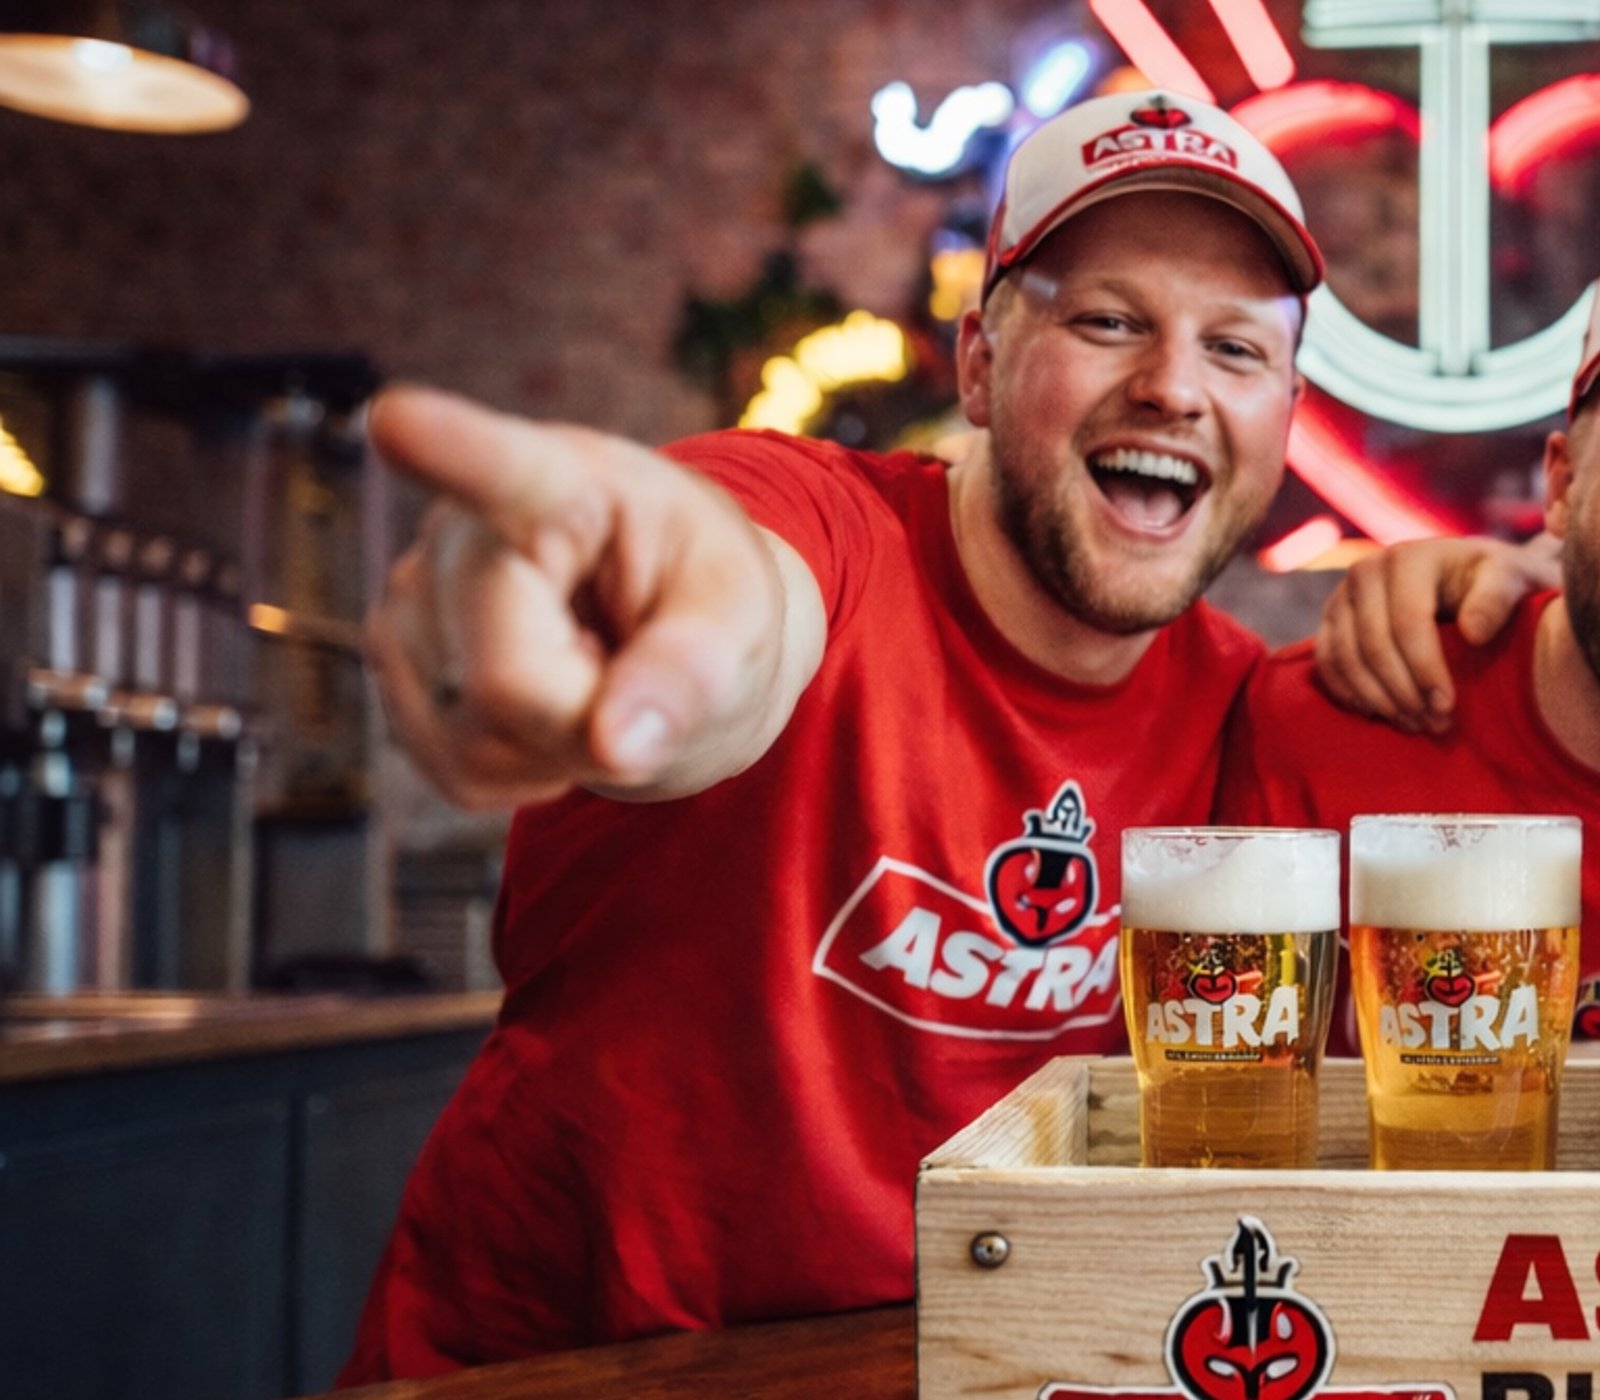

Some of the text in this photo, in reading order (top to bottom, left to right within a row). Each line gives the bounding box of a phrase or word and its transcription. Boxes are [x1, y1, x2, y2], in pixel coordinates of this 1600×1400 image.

[1093, 129, 1231, 165] ASTRA
[859, 906, 1119, 1011] ASTRA
[1146, 985, 1299, 1048] ASTRA
[1380, 984, 1540, 1051] ASTRA
